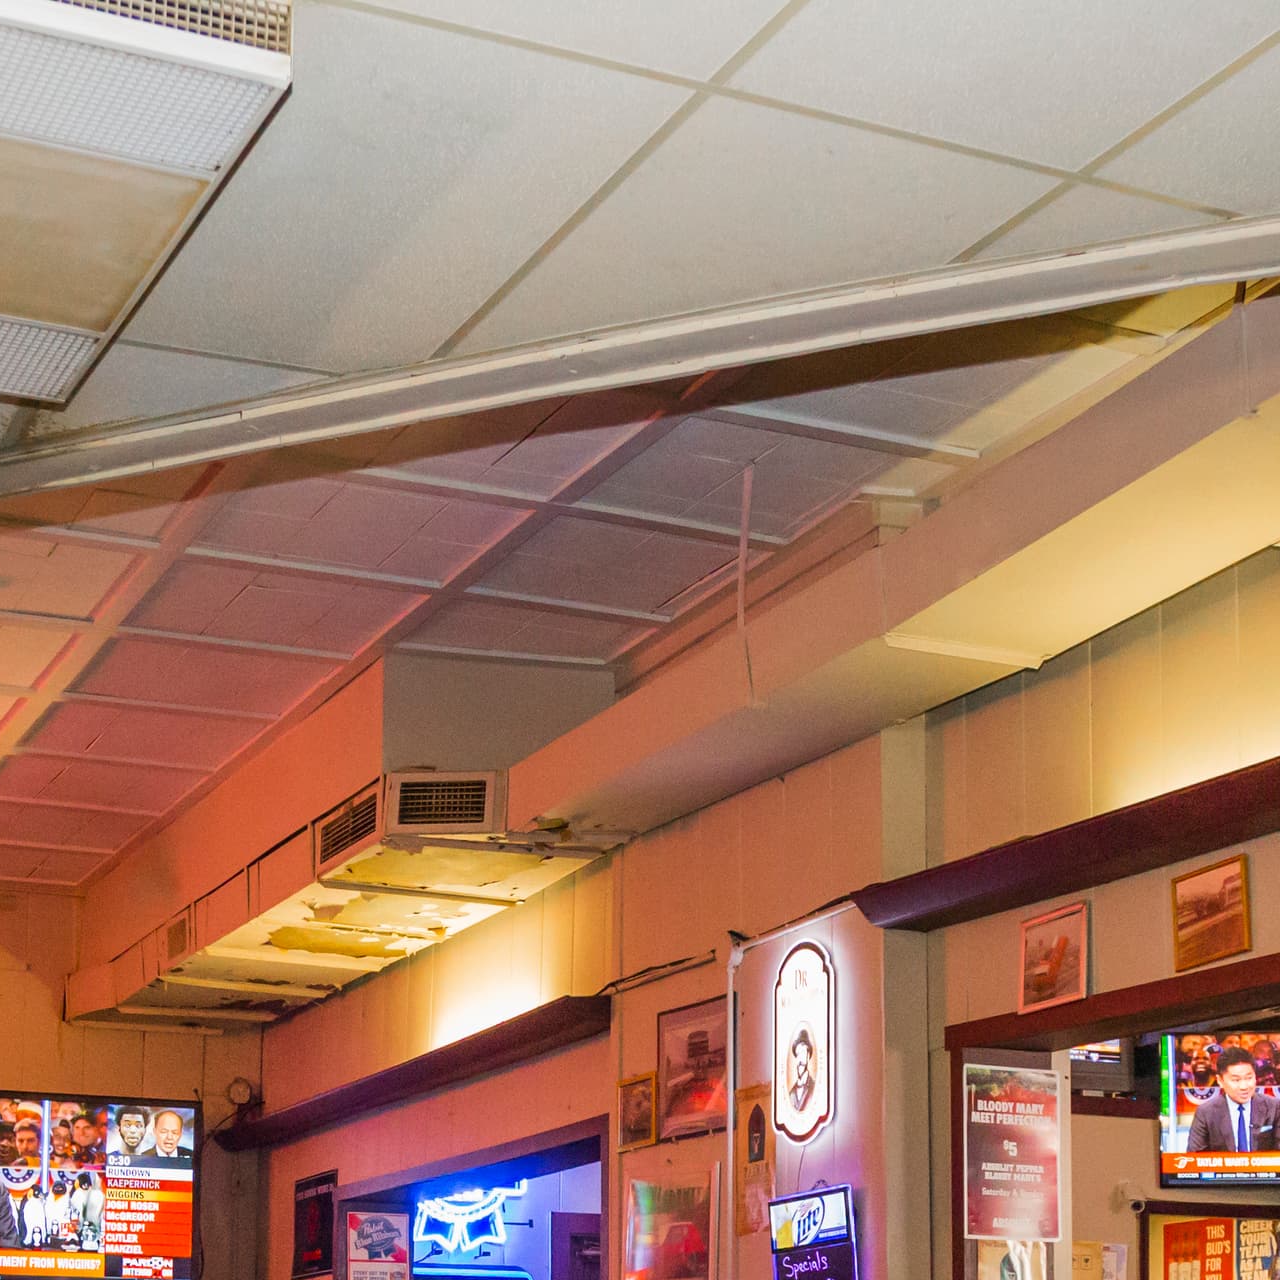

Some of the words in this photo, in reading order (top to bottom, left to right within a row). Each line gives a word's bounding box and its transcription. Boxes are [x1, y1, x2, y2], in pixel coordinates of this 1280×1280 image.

[977, 1099, 1014, 1114] BLOODY
[1016, 1102, 1045, 1115] MARY
[971, 1111, 995, 1124] MEET
[996, 1113, 1053, 1129] PERFECTION
[1002, 1139, 1018, 1157] $5
[107, 1169, 151, 1178] RUNDOWN
[984, 1171, 1012, 1182] BLOODY
[107, 1179, 161, 1190] KAEPERNICK
[107, 1190, 145, 1200] WIGGINS
[106, 1200, 129, 1210] JOSH
[106, 1211, 155, 1222] McGREGOR
[106, 1221, 128, 1232] TOSS
[363, 1221, 384, 1235] Pabst
[796, 1206, 820, 1244] Lite
[1205, 1224, 1225, 1241] THIS
[1240, 1220, 1273, 1234] CHEER
[106, 1233, 138, 1243] CUTLER
[355, 1236, 372, 1250] Blue
[372, 1230, 400, 1245] Ribbon
[1240, 1231, 1267, 1247] YOUR
[1206, 1240, 1231, 1257] BUD'S
[1240, 1245, 1272, 1260] TEAM
[29, 1256, 56, 1268] FROM
[57, 1257, 101, 1270] WIGGINS?
[782, 1250, 829, 1280] Specials
[1205, 1257, 1222, 1273] FOR
[1240, 1258, 1253, 1272] AS
[1254, 1257, 1263, 1271] A
